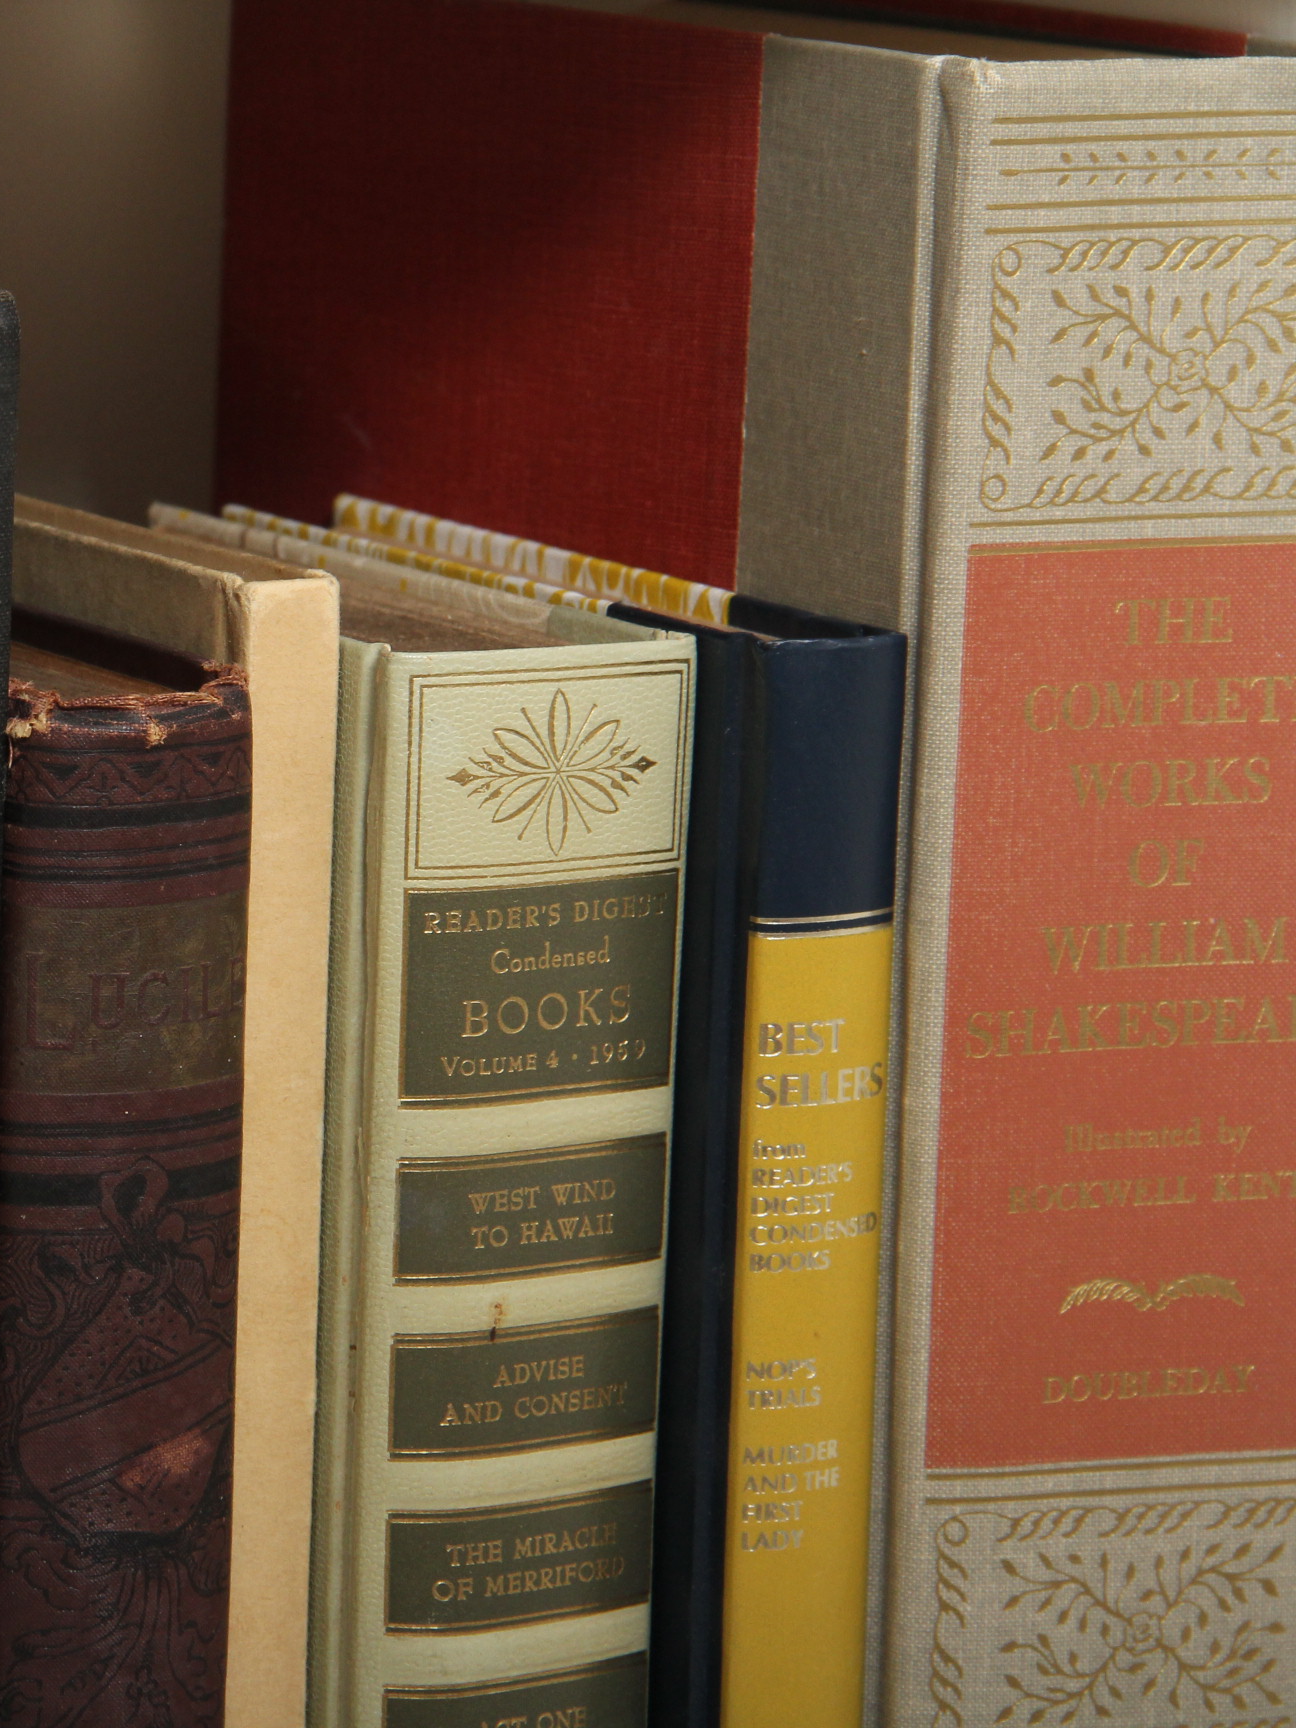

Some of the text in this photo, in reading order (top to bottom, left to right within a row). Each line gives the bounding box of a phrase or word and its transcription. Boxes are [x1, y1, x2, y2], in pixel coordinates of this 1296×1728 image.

[1114, 596, 1233, 645] THE
[1023, 675, 1296, 733] COMPLET
[1067, 755, 1273, 808] WORKS
[1127, 838, 1204, 888] OF
[423, 892, 667, 934] READER'S DIGEST
[490, 935, 611, 974] Condensed
[1041, 916, 1290, 975] WILLIAM
[461, 984, 632, 1037] BOOKS
[964, 996, 1296, 1058] SHAKESPEA
[757, 1018, 847, 1057] BEST
[441, 1038, 647, 1078] VOLUME 4 1959
[754, 1061, 883, 1109] SELLERS
[752, 1139, 807, 1160] from
[1063, 1116, 1254, 1154] Illustrated by
[751, 1161, 853, 1188] READER'S
[467, 1178, 616, 1215] WEST WIND
[751, 1192, 835, 1217] DIGEST
[1007, 1175, 1197, 1214] ROCKWELL
[471, 1213, 615, 1249] TO HAWAII
[749, 1211, 877, 1246] CONDENSED
[748, 1249, 831, 1273] BOOKS
[493, 1355, 586, 1388] ADVISE
[1042, 1364, 1256, 1404] DOUBLEDAY
[439, 1381, 628, 1427] AND CONSENT
[745, 1386, 823, 1411] TRIALS
[742, 1439, 839, 1466] MURDER
[743, 1466, 841, 1495] AND THE
[741, 1500, 804, 1523] FIRST
[446, 1522, 618, 1567] THE MIRACLE
[740, 1529, 804, 1553] LADY
[432, 1556, 625, 1602] OF MERRIFORD
